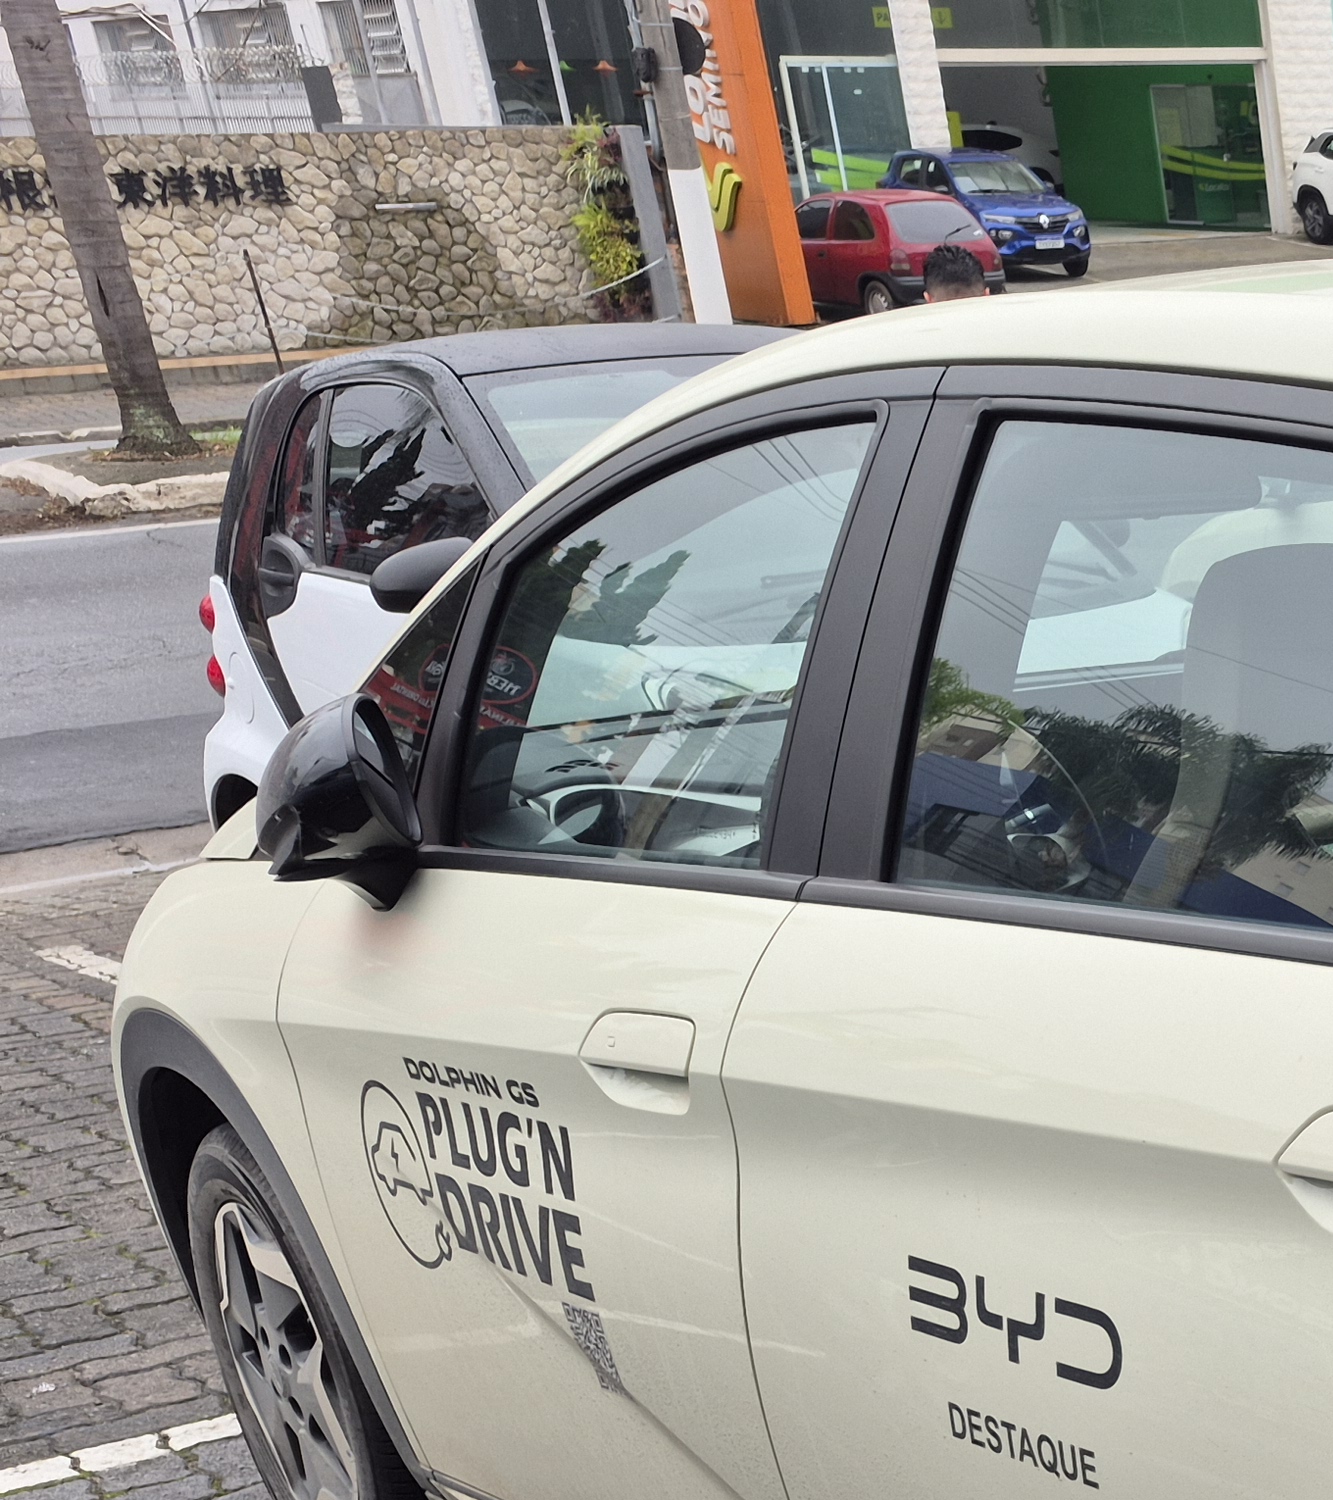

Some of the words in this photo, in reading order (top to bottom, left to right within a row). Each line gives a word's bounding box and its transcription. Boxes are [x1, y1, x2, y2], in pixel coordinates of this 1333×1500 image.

[402, 1056, 503, 1100] DOLPHIN
[504, 1079, 540, 1108] GS
[415, 1091, 576, 1202] PLUG'N
[434, 1172, 597, 1304] DRIVE
[907, 1255, 1123, 1390] BYD
[948, 1401, 1101, 1490] DESTAQUE
